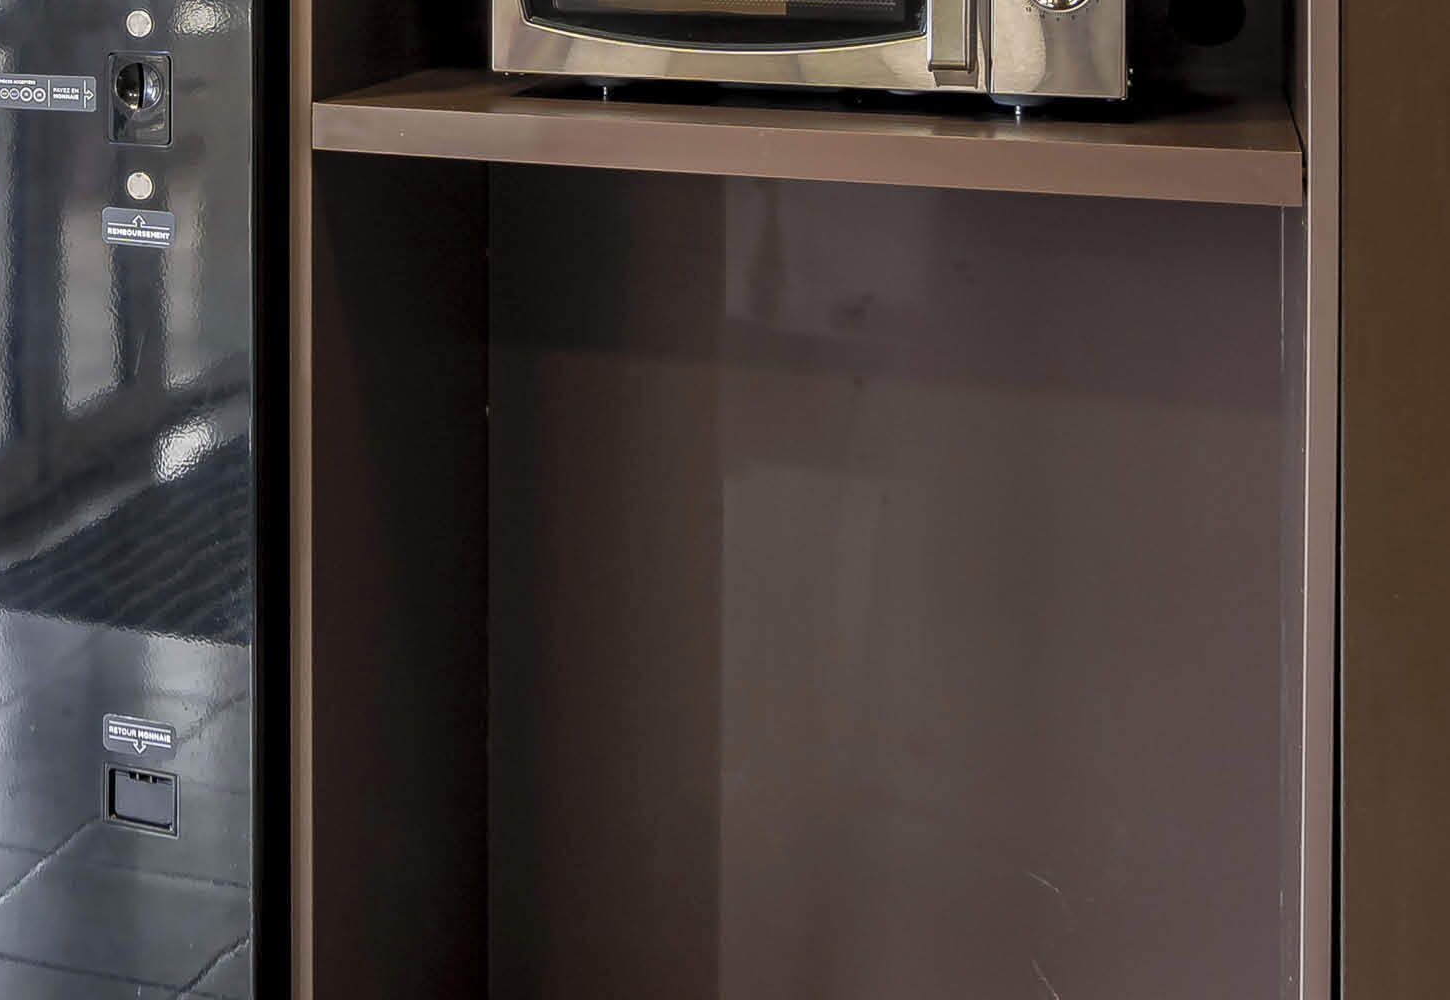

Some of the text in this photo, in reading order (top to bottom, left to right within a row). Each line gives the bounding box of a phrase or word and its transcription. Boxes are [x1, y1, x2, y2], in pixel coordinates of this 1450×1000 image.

[107, 226, 171, 240] REMBOURSEMENT
[109, 725, 171, 742] RETOUR MONNAIE
